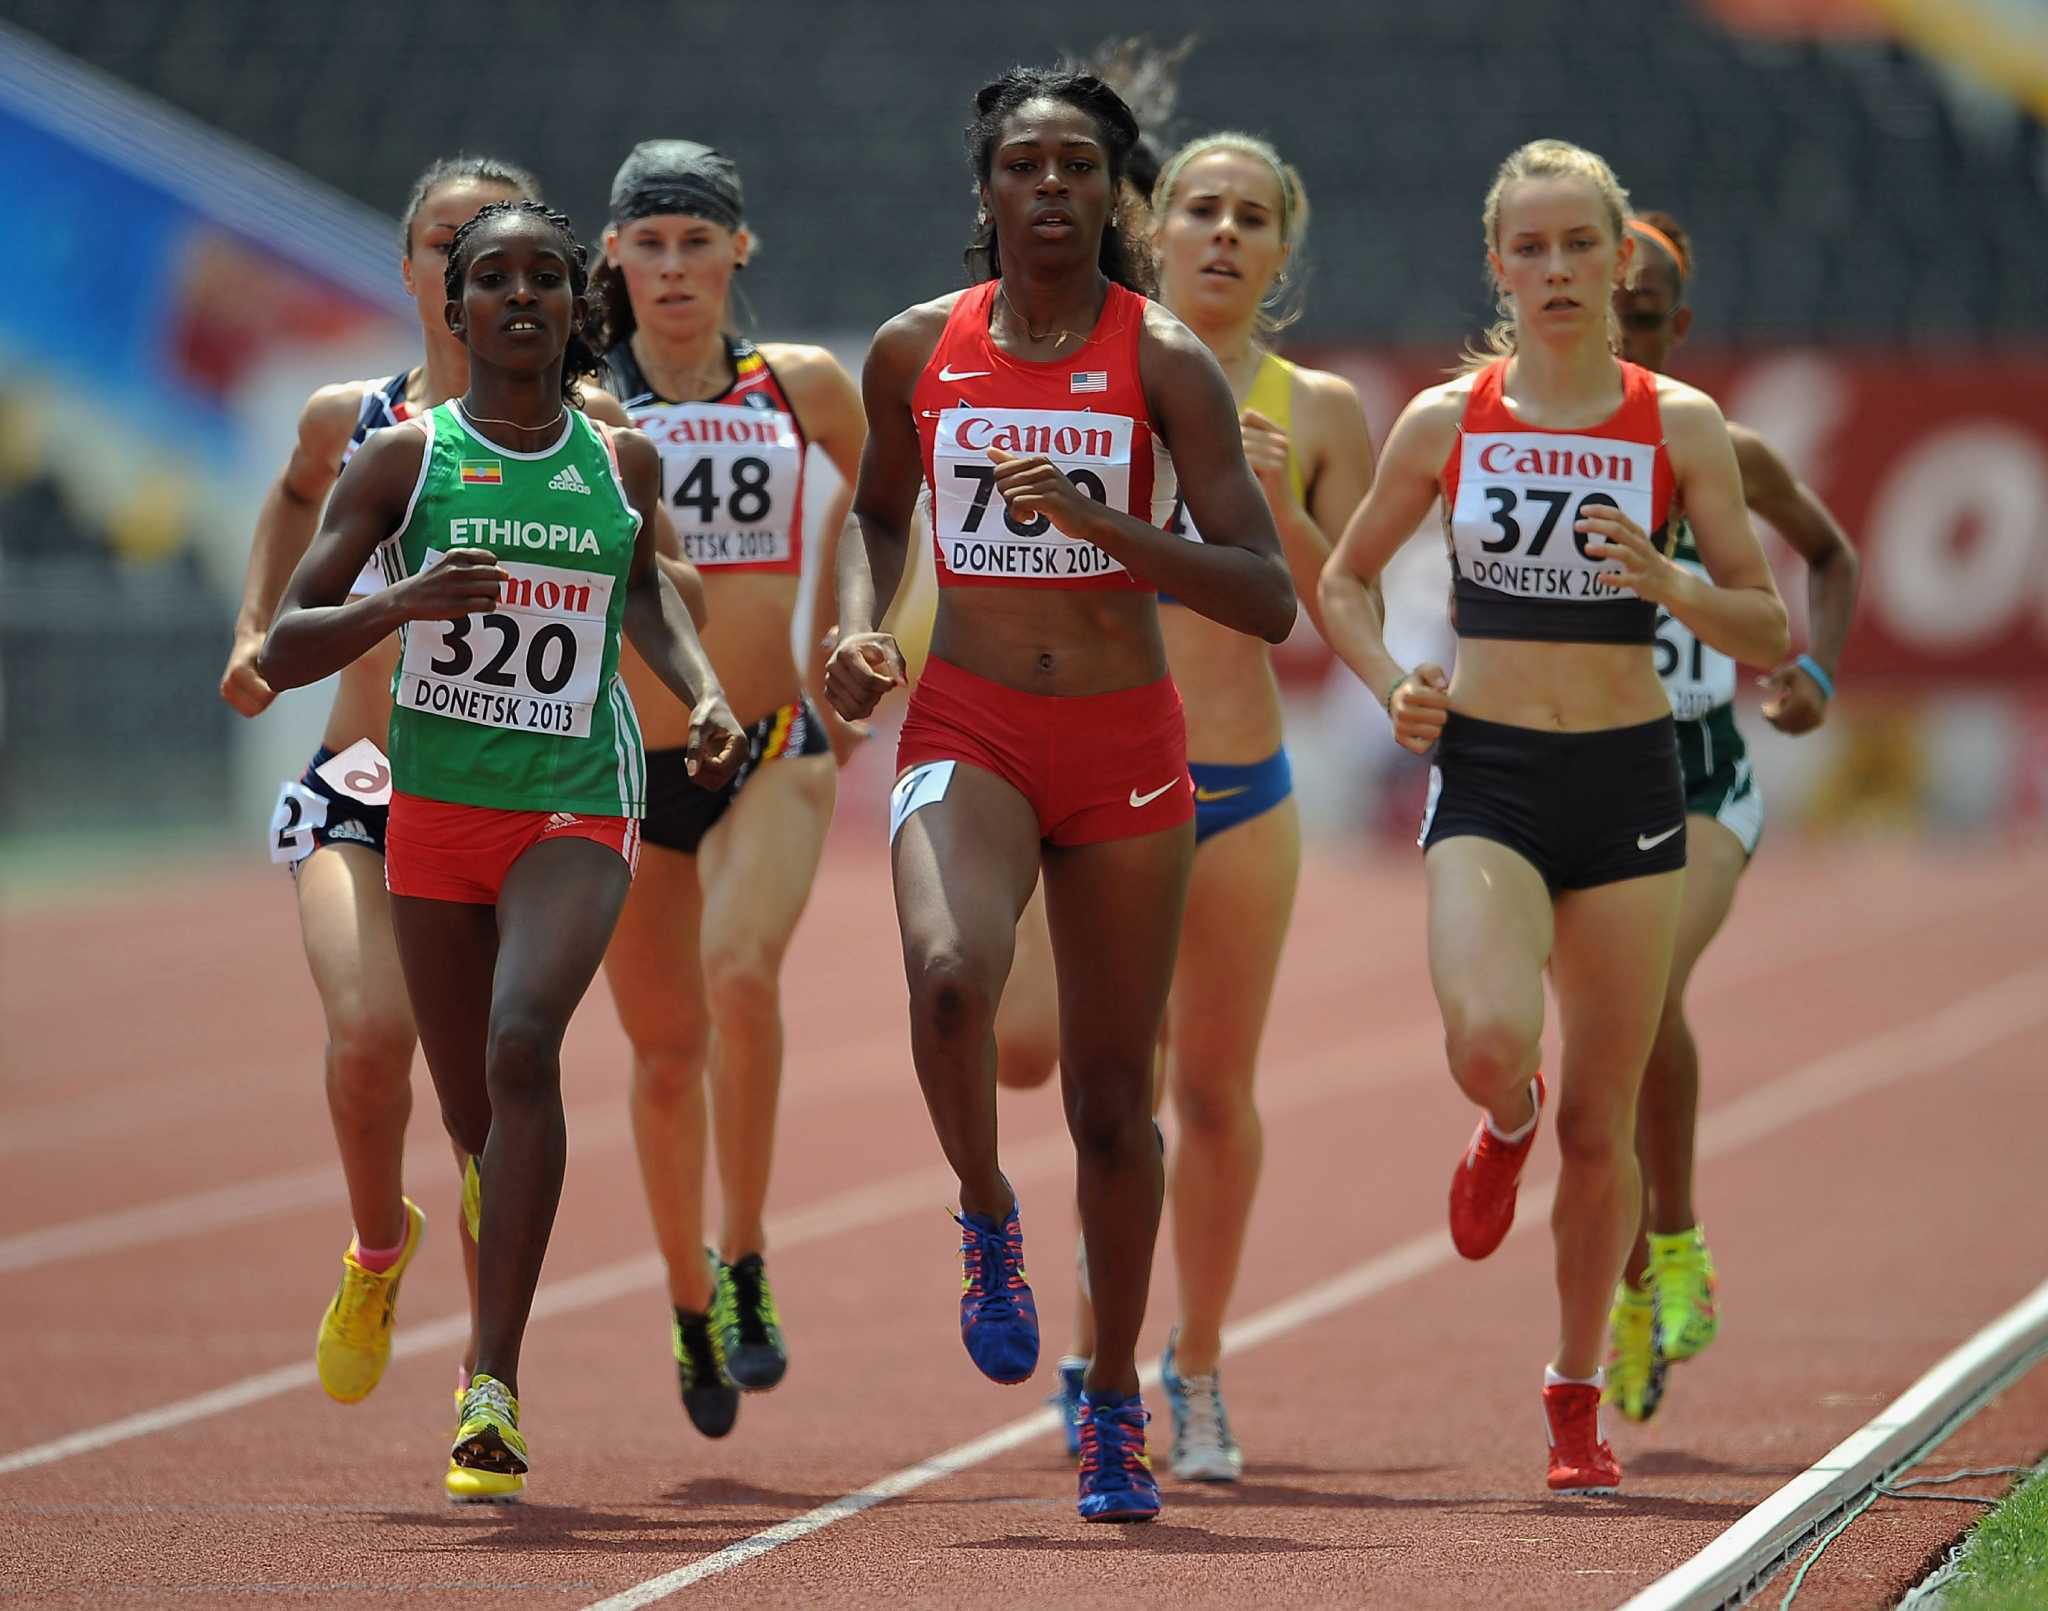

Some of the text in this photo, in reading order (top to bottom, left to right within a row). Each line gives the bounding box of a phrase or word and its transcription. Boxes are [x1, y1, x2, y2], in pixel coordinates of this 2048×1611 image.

[954, 417, 1113, 458] Canon
[1479, 442, 1633, 482] Canon
[548, 479, 592, 496] adidas
[449, 518, 601, 556] ETHIOPIA
[952, 542, 1110, 574] DONETSK 2013
[496, 577, 591, 613] non
[1473, 560, 1573, 595] DONETSK
[430, 612, 578, 695] 320
[414, 679, 573, 732] DONETSK 2013
